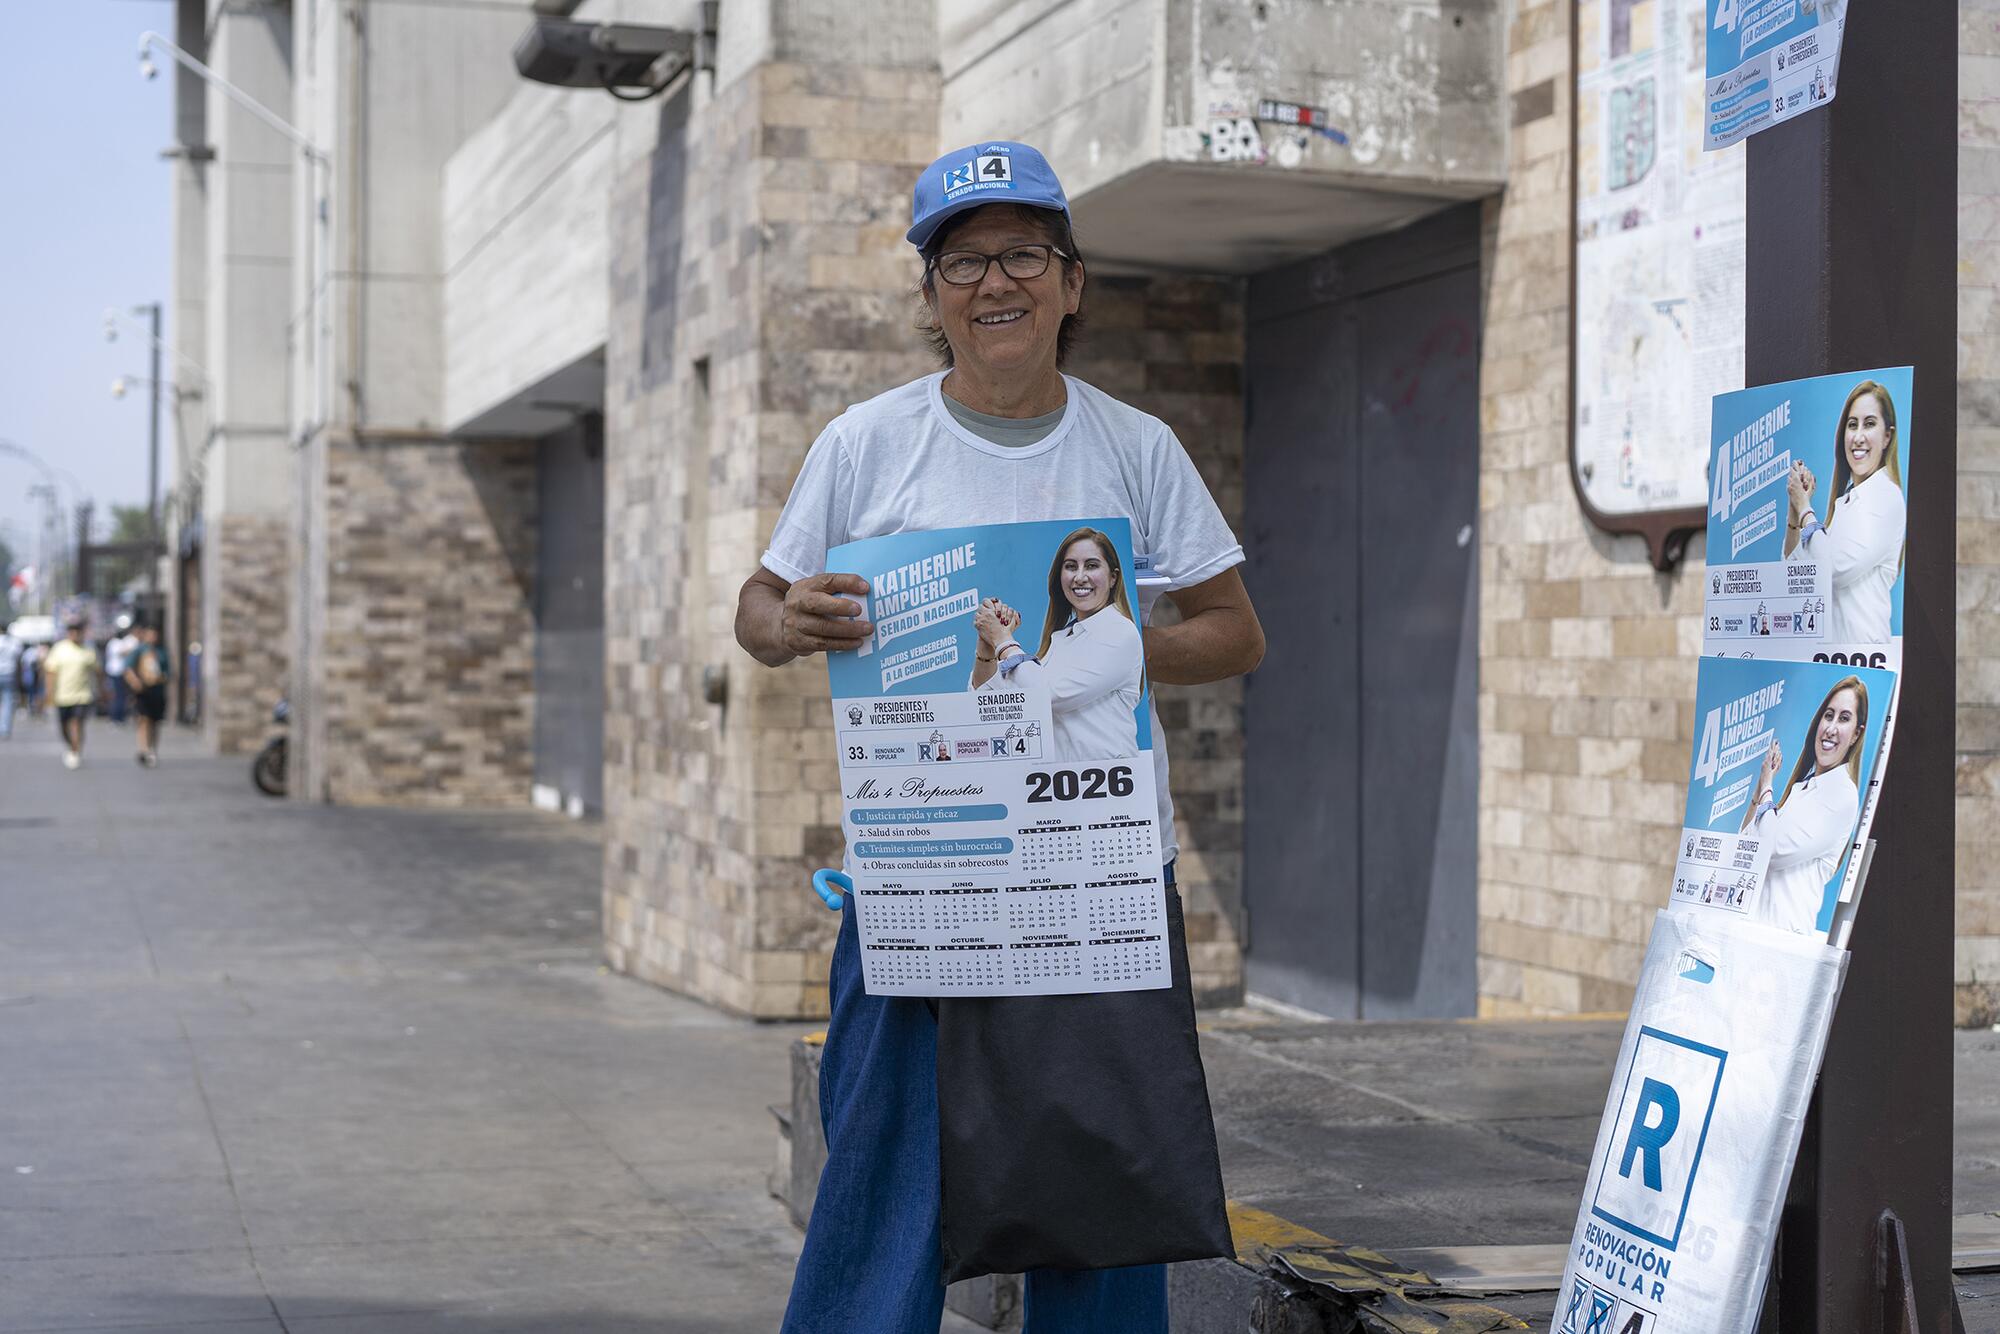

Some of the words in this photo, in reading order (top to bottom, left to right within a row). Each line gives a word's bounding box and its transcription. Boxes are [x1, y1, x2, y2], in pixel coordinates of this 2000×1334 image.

[983, 158, 1006, 178] 4
[948, 186, 973, 200] SENADO
[1734, 400, 1790, 459] KATHERINE
[1733, 438, 1774, 481] AMPUERO
[1712, 440, 1731, 523] 4
[1734, 479, 1756, 501] SENADO
[1758, 457, 1789, 486] NACIONAL
[873, 543, 976, 599] KATHERINE
[1727, 570, 1754, 581] PRESIDENTES
[1787, 565, 1816, 577] SENADORES
[1724, 582, 1761, 593] VICEPRESIDENTES
[875, 577, 949, 620] AMPUERO
[881, 613, 920, 637] SENADO
[924, 594, 976, 622] NACIONAL
[1794, 614, 1803, 632] R
[1808, 614, 1814, 631] 4
[1710, 617, 1721, 631] 33.
[1751, 616, 1759, 632] R
[910, 635, 957, 658] VENCEREMOS
[886, 672, 891, 682] A
[894, 669, 902, 679] LA
[905, 650, 956, 675] CORRUPCIÓN!
[874, 701, 921, 713] PRESIDENTES
[923, 701, 928, 710] Y
[978, 693, 1025, 705] SENADORES
[1724, 680, 1784, 728] KATHERINE
[870, 712, 934, 724] VICEPRESIDENTES
[980, 713, 1004, 721] (DISTRITO
[1005, 712, 1023, 720] ÚNICO)
[984, 706, 997, 714] NIVEL
[1721, 713, 1765, 750] AMPUERO
[849, 746, 868, 760] 33.
[920, 745, 932, 760] R
[1015, 738, 1026, 753] 4
[1694, 706, 1721, 788] 4
[1720, 752, 1744, 769] SENADO
[847, 778, 879, 799] Mis
[883, 787, 894, 797] 4
[899, 777, 984, 803] Propuestas
[1026, 766, 1134, 803] 2026
[857, 813, 864, 821] 1.
[866, 811, 896, 822] Justicia
[898, 811, 924, 823] rápida
[926, 813, 931, 821] y
[934, 809, 958, 818] eficaz
[859, 829, 866, 837] 2.
[867, 828, 890, 836] Salud
[892, 828, 904, 836] sin
[907, 827, 930, 836] robos
[860, 846, 868, 854] 3.
[869, 844, 905, 853] Trámites
[907, 844, 938, 854] simples
[940, 843, 953, 851] sin
[955, 841, 1001, 851] burocracia
[862, 862, 870, 870] 4.
[871, 861, 895, 870] Obras
[898, 860, 941, 869] concluidas
[944, 860, 956, 868] sin
[958, 858, 1008, 867] sobrecostos
[1736, 890, 1744, 905] 4
[1102, 929, 1146, 937] DICIEMBRE
[1618, 1076, 1681, 1192] R
[1584, 1222, 1671, 1279] RENOVACIÓN
[1578, 1245, 1665, 1303] POPULAR
